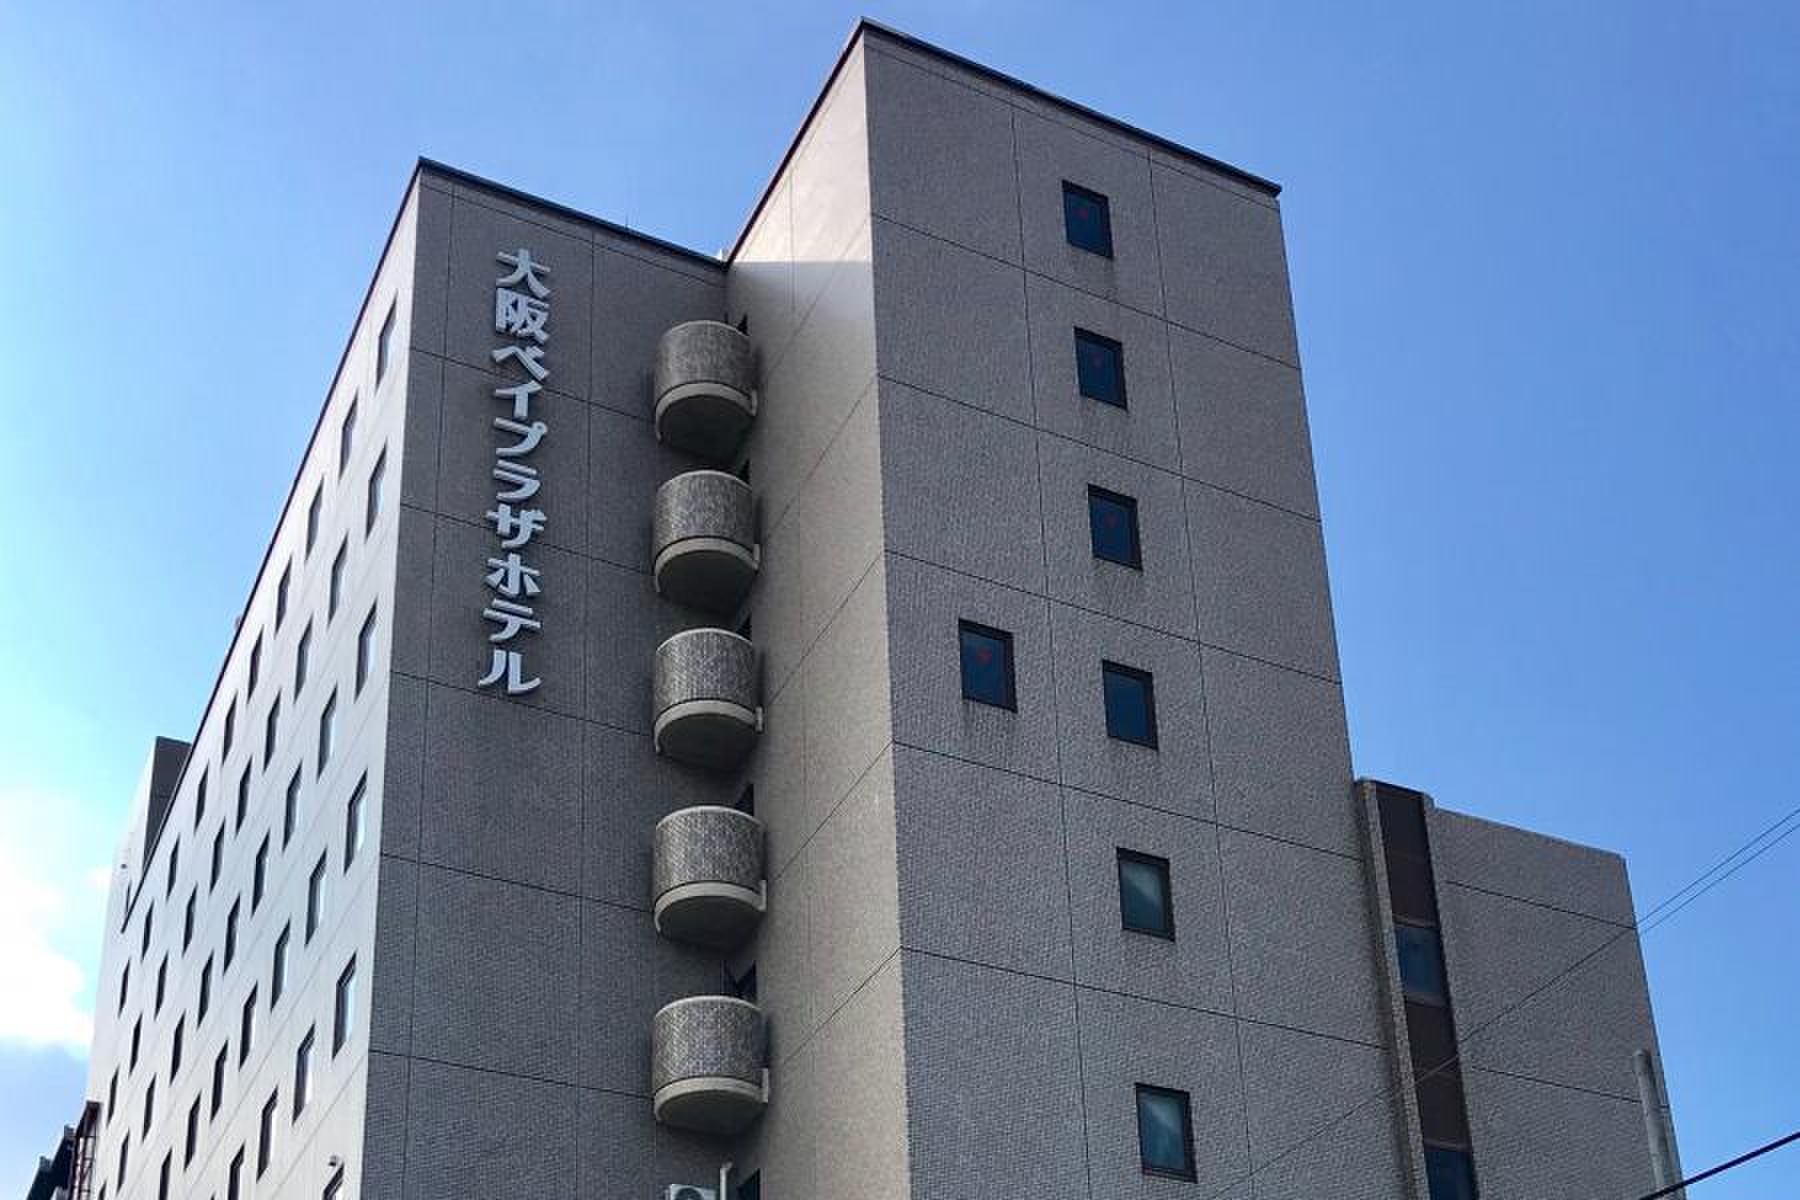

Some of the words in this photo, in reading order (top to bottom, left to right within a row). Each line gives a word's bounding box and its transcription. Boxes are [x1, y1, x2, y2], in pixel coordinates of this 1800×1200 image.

[478, 248, 551, 695] 大阪ベイプラザホテル
